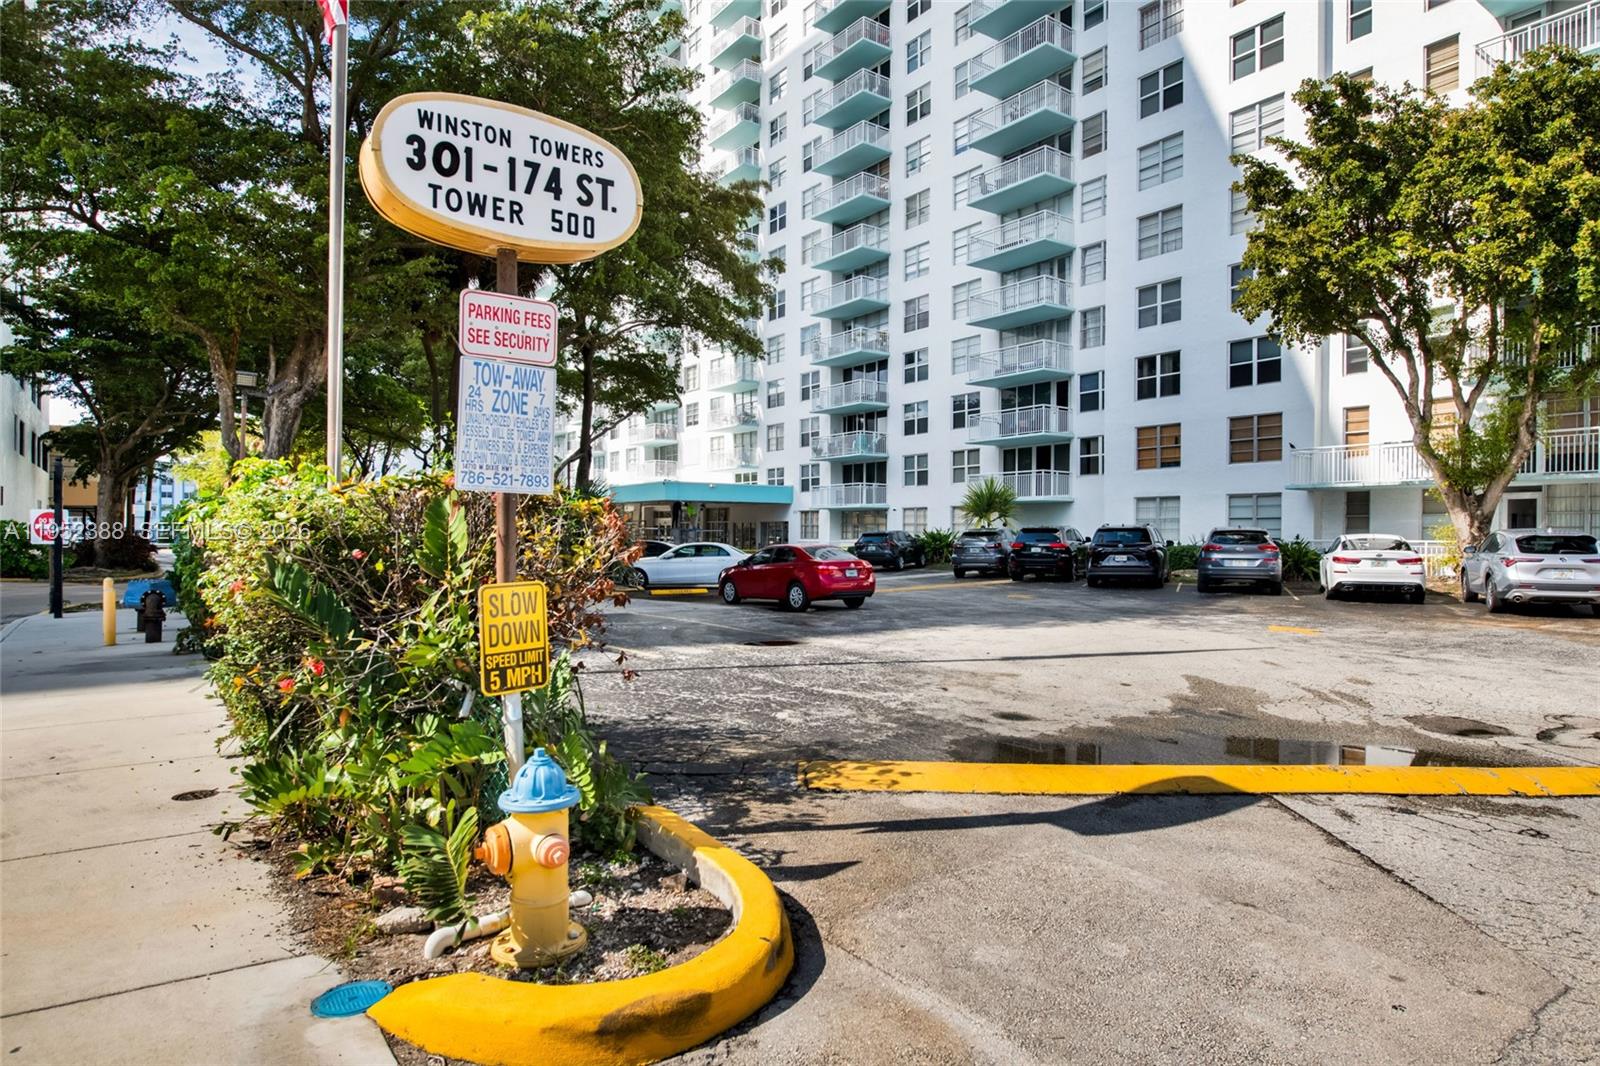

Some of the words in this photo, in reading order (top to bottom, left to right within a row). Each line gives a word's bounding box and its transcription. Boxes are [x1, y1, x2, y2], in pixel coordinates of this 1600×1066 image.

[417, 108, 511, 148] WINSTON
[529, 135, 604, 168] TOWERS
[405, 134, 563, 201] 301-174
[576, 173, 618, 214] ST.
[428, 183, 525, 226] TOWER
[551, 209, 595, 239] 500
[468, 302, 521, 325] PARKING
[524, 311, 551, 330] FEES
[467, 327, 490, 346] SEE
[494, 332, 549, 352] SECURITY
[473, 361, 545, 392] TOW-AWAY
[464, 399, 484, 412] HRS
[533, 406, 551, 419] DAYS
[468, 385, 481, 399] 24
[491, 389, 528, 416] ZONE
[539, 394, 546, 405] 7
[462, 425, 489, 438] VESSELS
[491, 427, 505, 439] WILL
[516, 429, 536, 442] TOWED
[465, 412, 511, 427] UNAUTHORIZED
[513, 417, 539, 430] VEHICLES
[540, 419, 549, 431] OR
[461, 450, 487, 463] DOLPHIN
[490, 452, 513, 466] TOWING
[520, 455, 549, 467] RECOVERY
[464, 438, 472, 449] AT
[474, 438, 501, 452] OWNERS
[502, 440, 514, 453] RISK
[523, 443, 549, 455] EXPENSE
[460, 470, 549, 488] 786-521-7893
[488, 591, 539, 618] SLOW
[488, 619, 541, 648] DOWN
[486, 654, 516, 669] SPEED
[519, 650, 544, 665] LIMIT
[489, 670, 501, 691] 5
[506, 665, 543, 688] MPH
